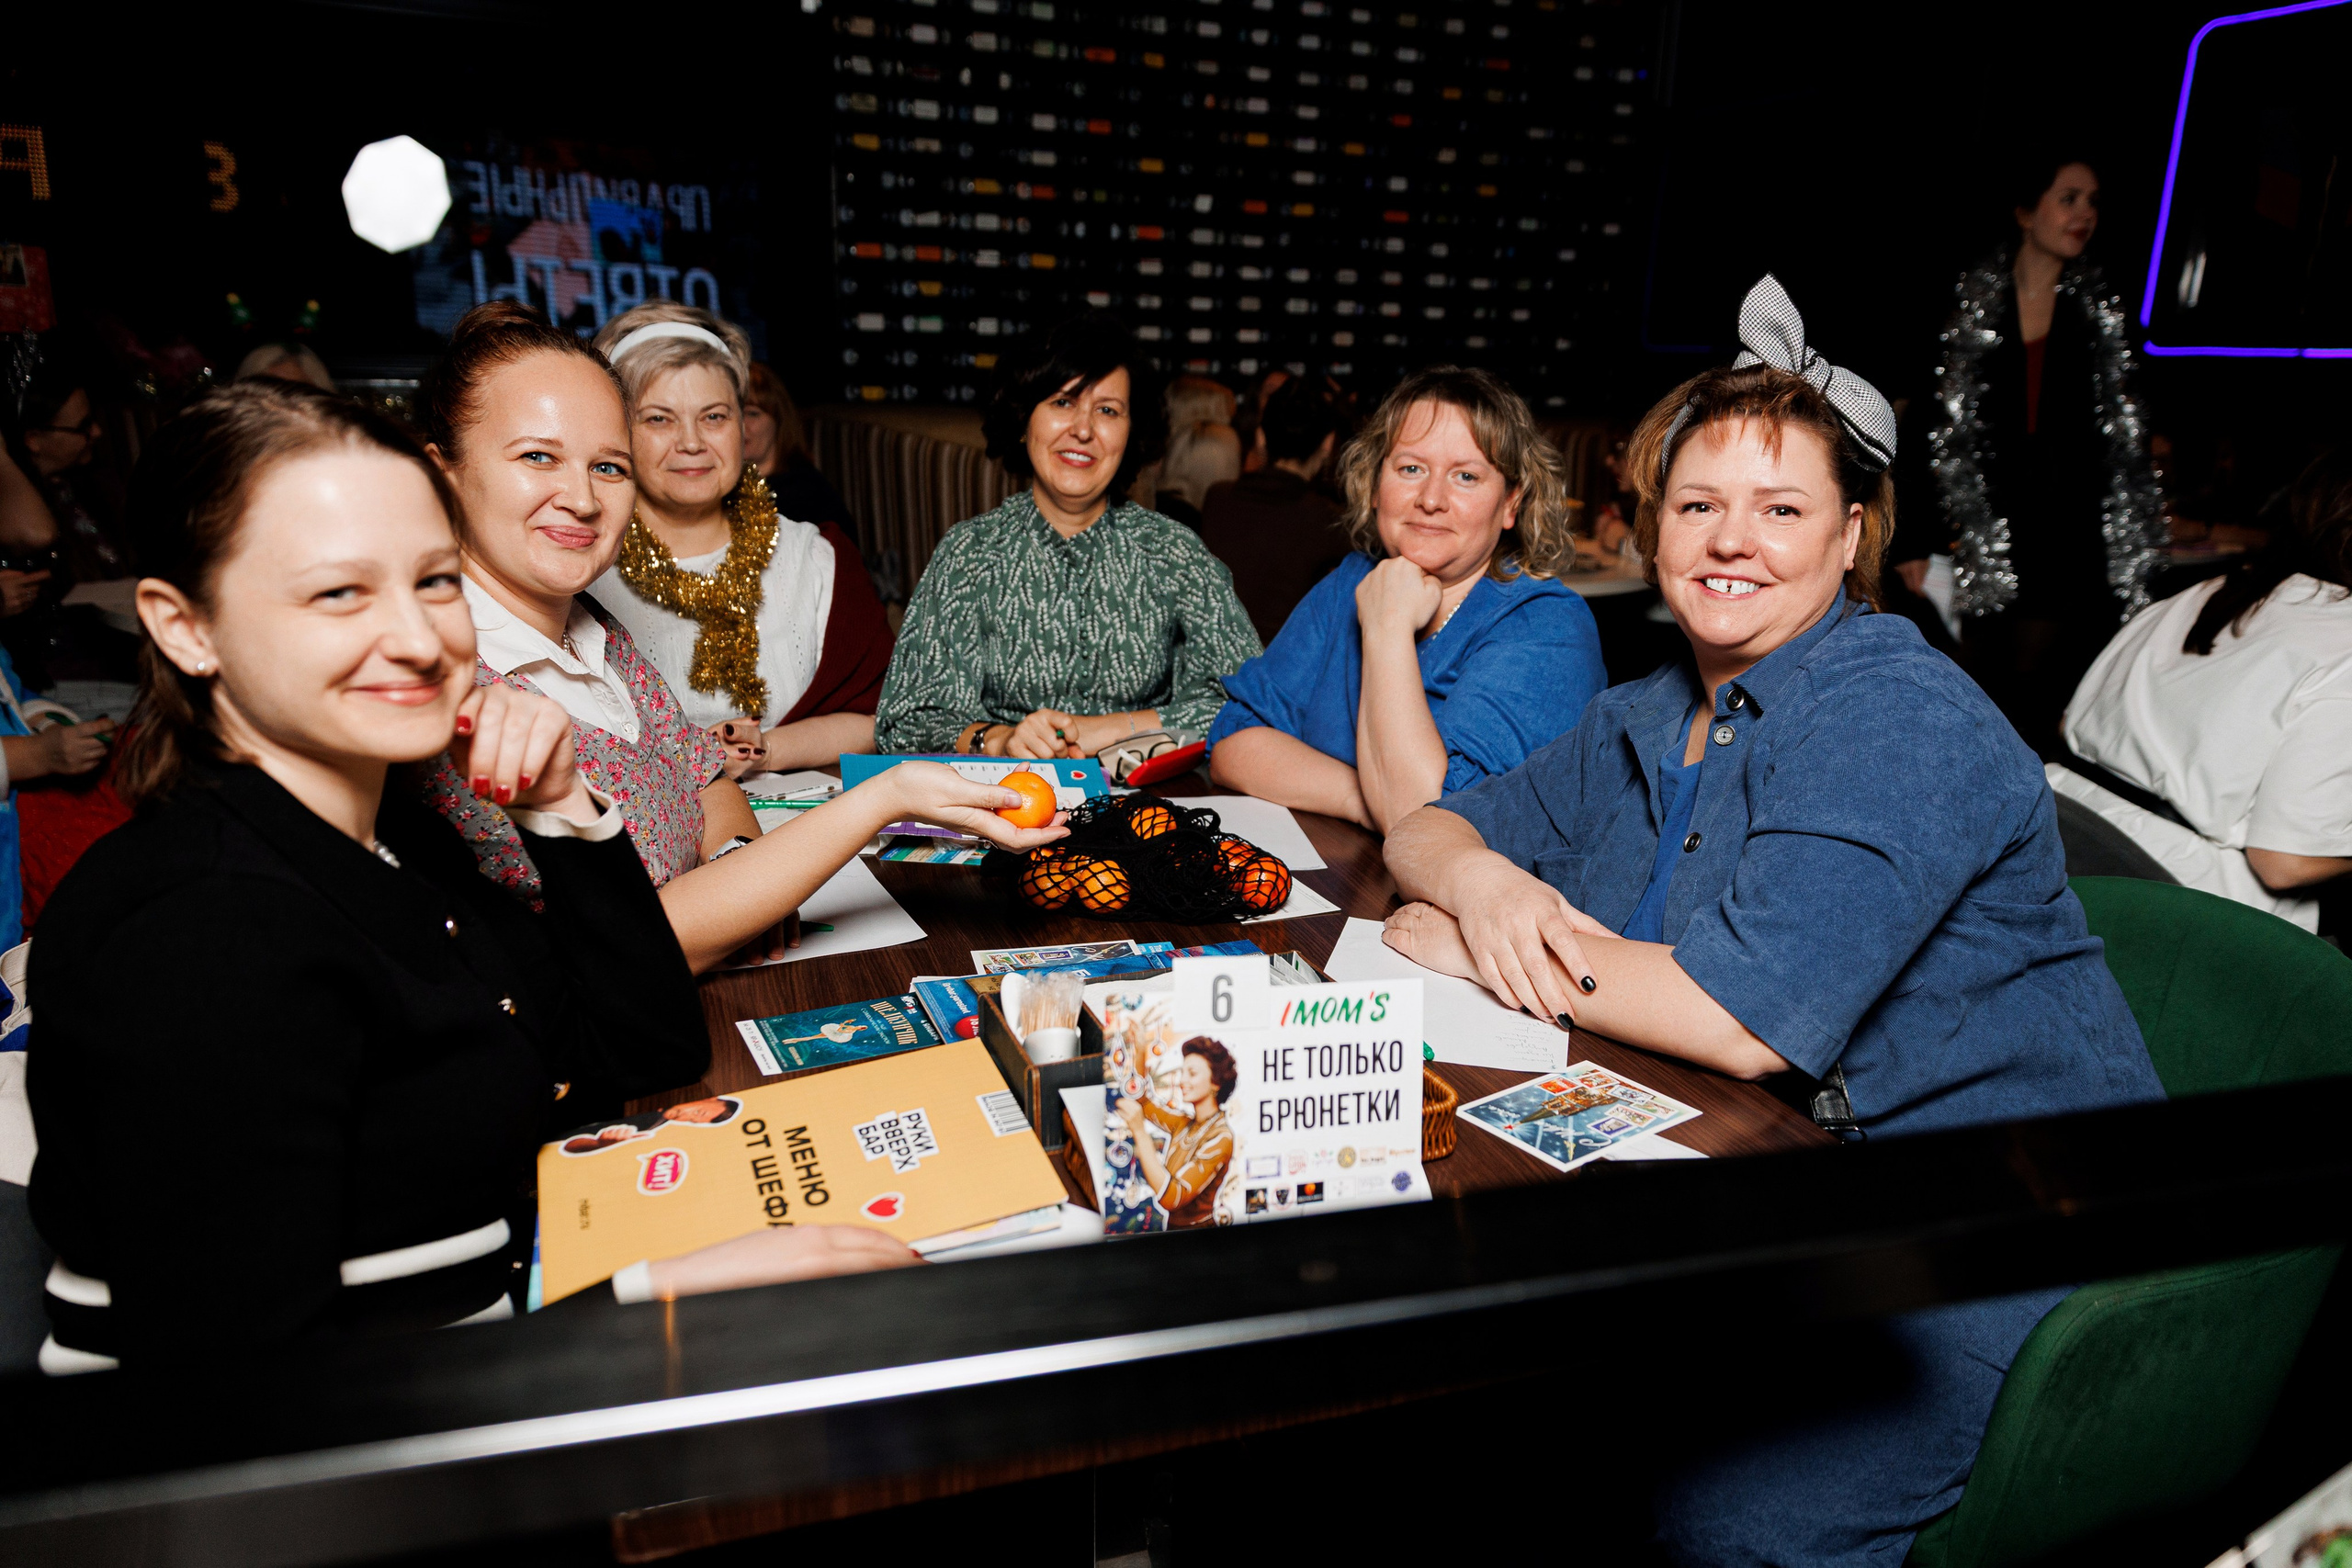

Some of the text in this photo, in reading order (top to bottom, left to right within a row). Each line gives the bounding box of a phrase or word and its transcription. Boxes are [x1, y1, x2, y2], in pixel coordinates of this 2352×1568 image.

[1213, 975, 1233, 1021] 6
[869, 1000, 918, 1045] ЩЕЛКУНЧИК
[1263, 1040, 1403, 1082] НЕ ТОЛЬКО
[902, 1112, 933, 1153] РУКИ
[1260, 1089, 1400, 1133] БРЮНЕТКИ
[741, 1118, 772, 1148] ОТ
[858, 1125, 885, 1155] БАР
[880, 1119, 916, 1170] ВВЕРХ
[649, 1154, 677, 1190] ХИТ!
[784, 1125, 829, 1206] МЕНЮ
